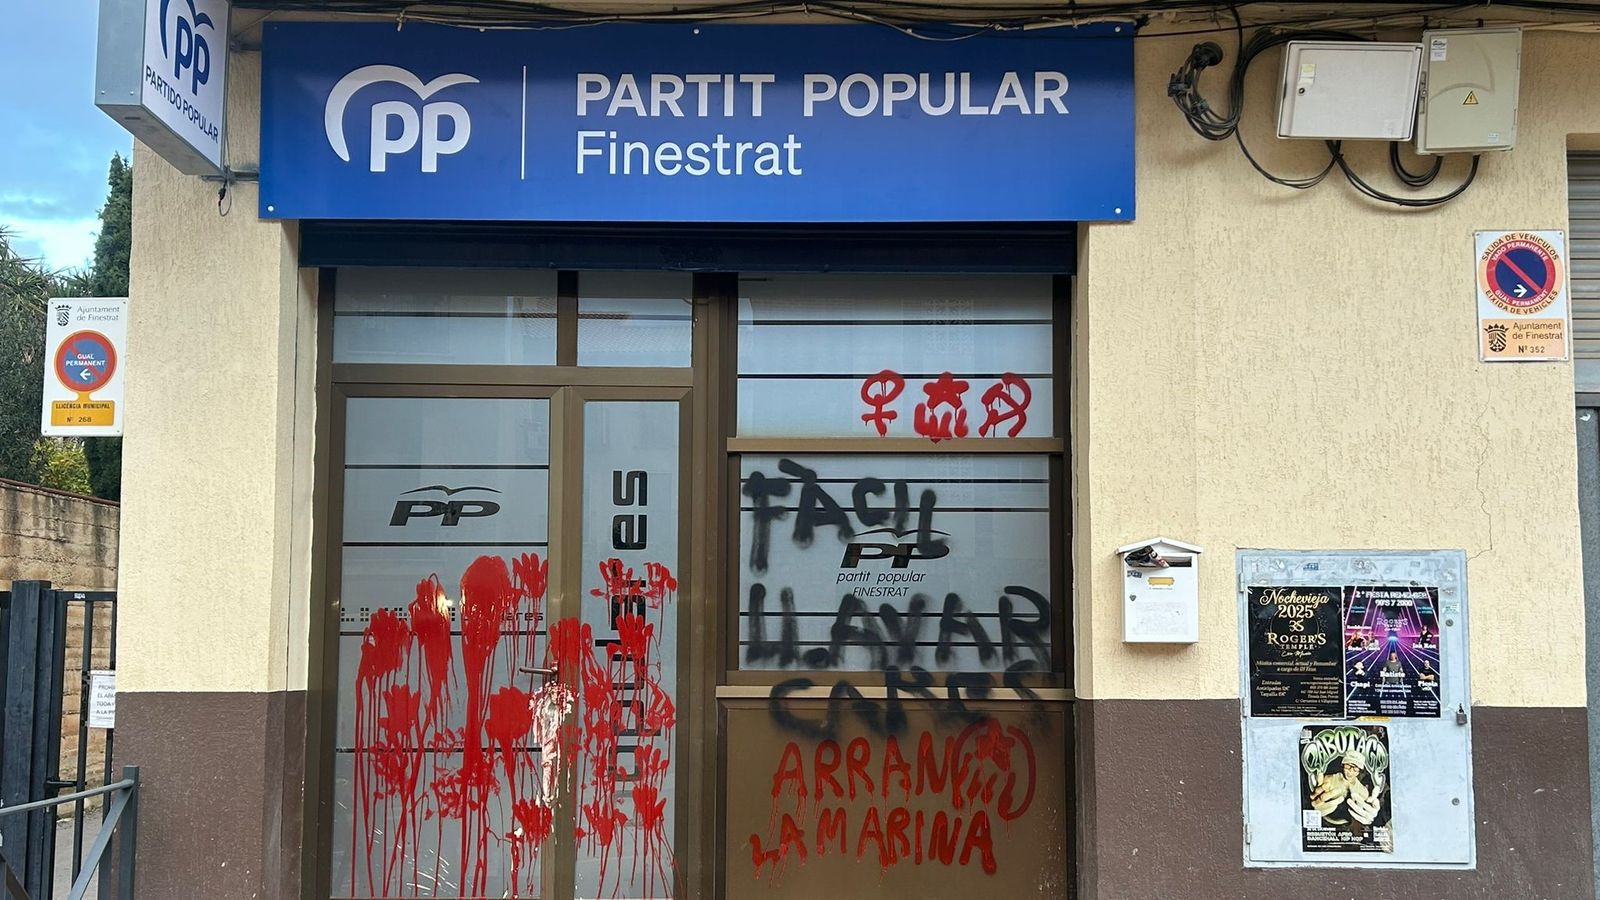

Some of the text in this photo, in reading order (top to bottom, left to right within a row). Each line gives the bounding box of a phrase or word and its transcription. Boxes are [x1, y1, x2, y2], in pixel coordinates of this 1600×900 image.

[576, 71, 1070, 117] PARTIT POPULAR
[145, 65, 219, 143] PARTIDO POPULAR
[576, 129, 802, 176] Finestrat
[1481, 238, 1503, 262] SALIDA
[1505, 233, 1517, 242] DE
[1491, 241, 1549, 262] VADO PERMANENTE
[1485, 290, 1559, 315] EIXIDA DE VEHICLES
[1494, 289, 1549, 306] GUAL PERMANENT
[77, 306, 120, 314] Ajuntament
[88, 313, 119, 321] Finestrat
[1512, 322, 1561, 332] Ajuntament
[1512, 331, 1563, 340] de Finestrat
[1530, 346, 1545, 354] 352
[836, 570, 927, 585] partit popular
[853, 587, 910, 597] FINESTRAT
[1259, 588, 1330, 609] Nochevieja
[1365, 590, 1390, 599] FIESTA
[1396, 599, 1413, 607] 2000
[1278, 604, 1315, 619] 2025
[1265, 632, 1327, 646] ROGER'S
[771, 731, 954, 803] ARRAN
[817, 807, 998, 875] MARINA
